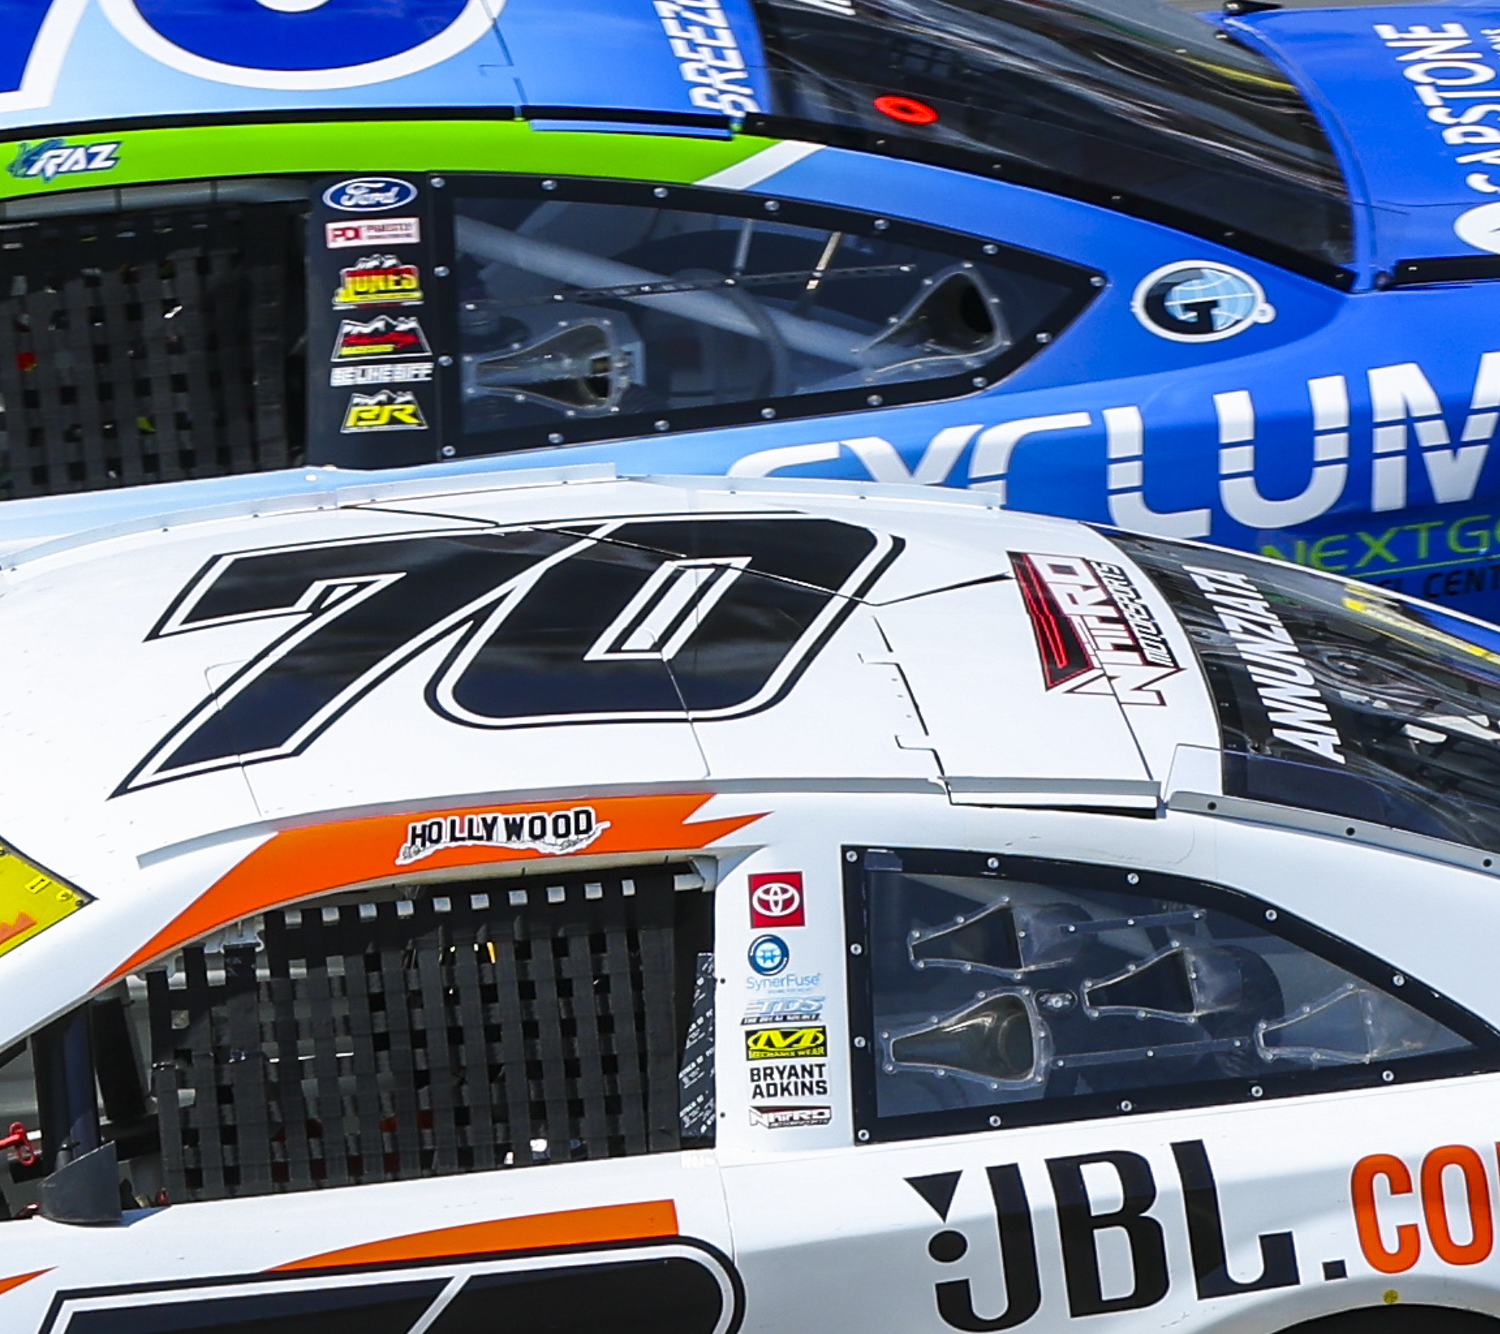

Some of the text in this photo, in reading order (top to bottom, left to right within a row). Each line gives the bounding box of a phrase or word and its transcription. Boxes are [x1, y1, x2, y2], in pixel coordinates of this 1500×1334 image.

[26, 141, 122, 179] RAZ
[339, 182, 400, 206] Ford
[1028, 553, 1187, 706] NITRO
[1090, 560, 1179, 668] MOTORSPORTS
[104, 510, 905, 799] 70
[1184, 565, 1345, 764] ANNUNZIATA
[410, 809, 593, 847] HOLLYWOOD
[746, 974, 818, 991] SynerFuse
[750, 1064, 827, 1082] BRYANT
[752, 1080, 828, 1099] ADKINS
